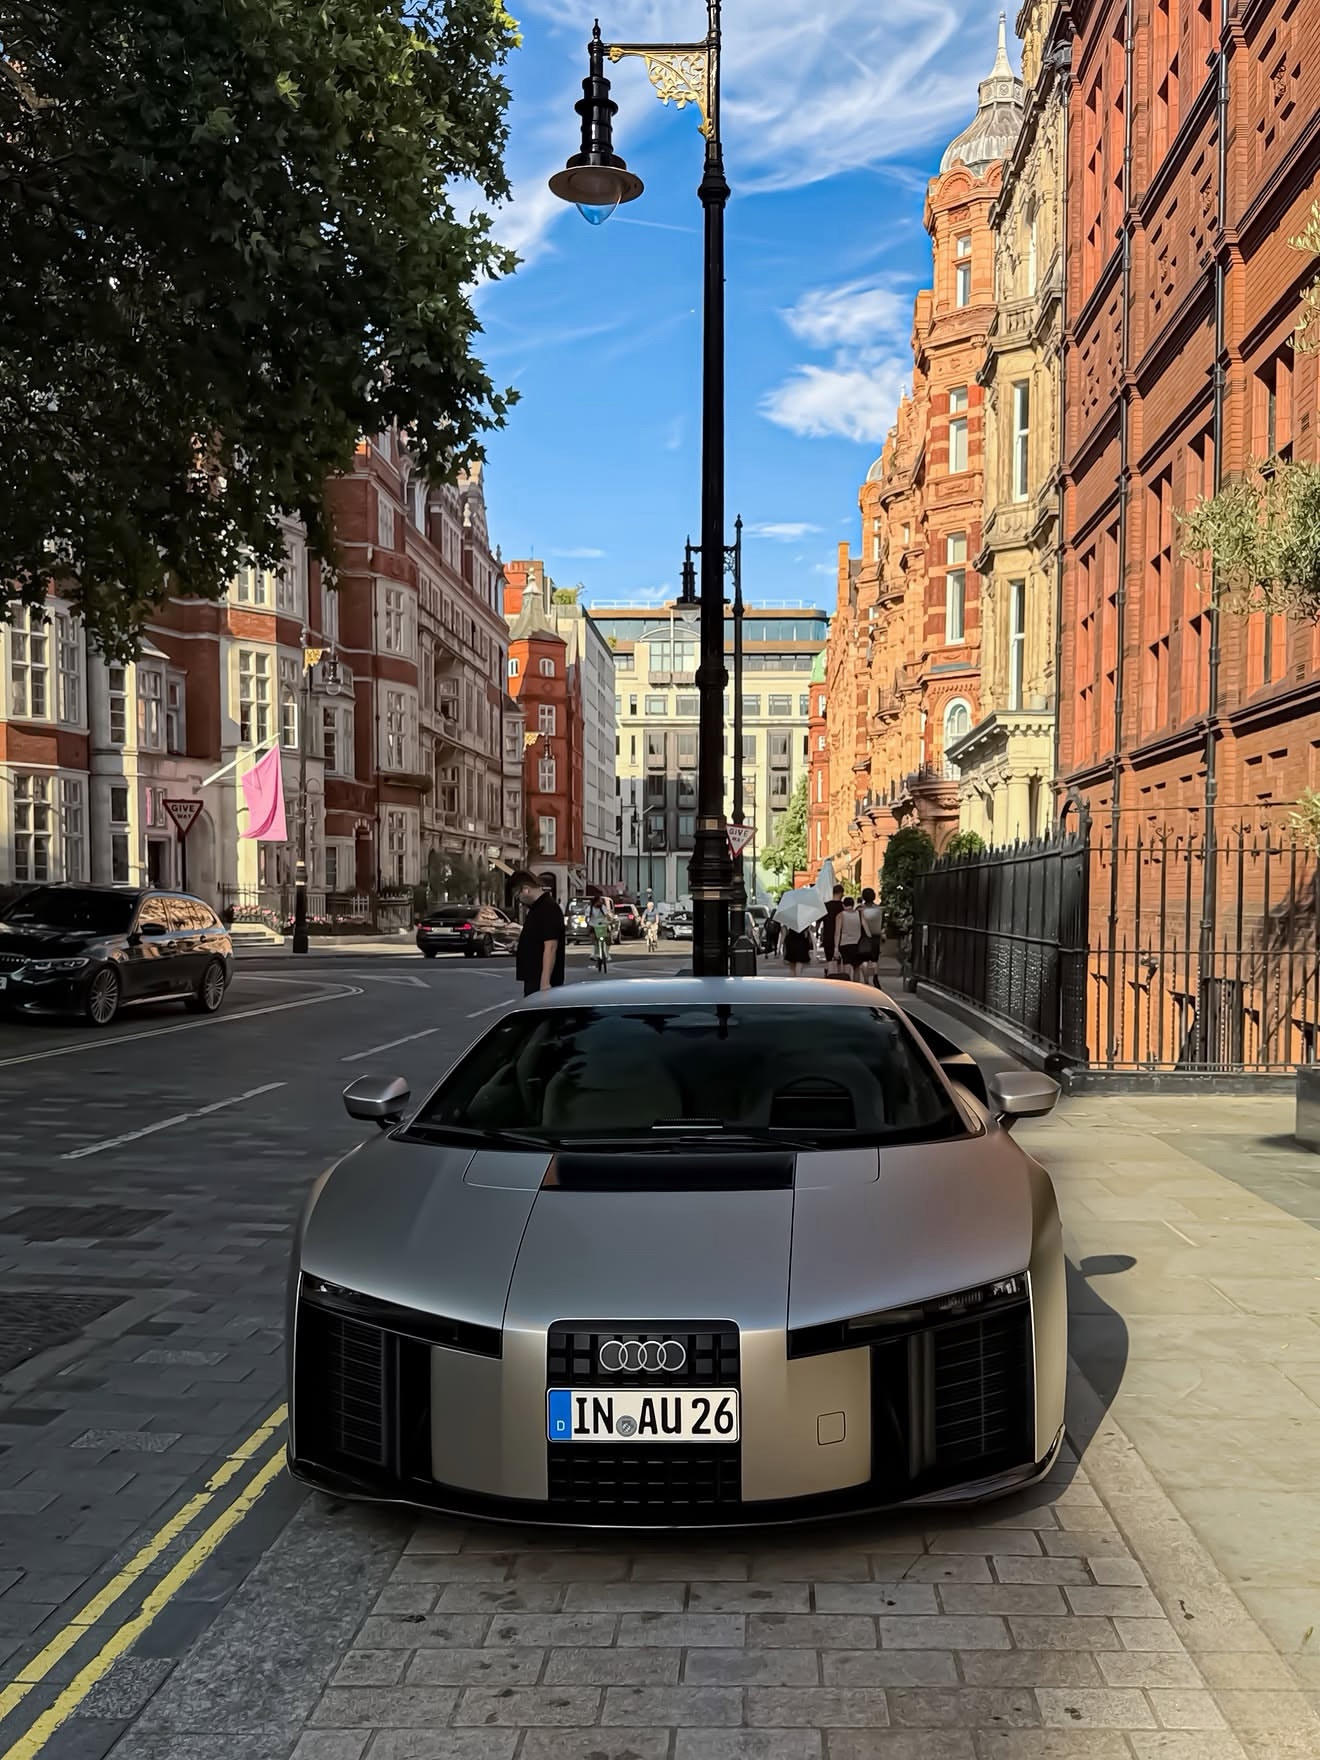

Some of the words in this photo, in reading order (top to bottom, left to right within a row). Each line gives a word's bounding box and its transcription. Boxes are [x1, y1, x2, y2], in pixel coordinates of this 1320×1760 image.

[171, 804, 195, 812] GIVE
[729, 828, 749, 837] GIVE
[574, 1397, 613, 1434] IN
[638, 1397, 682, 1434] AU
[691, 1397, 734, 1434] 26
[556, 1420, 565, 1431] D
